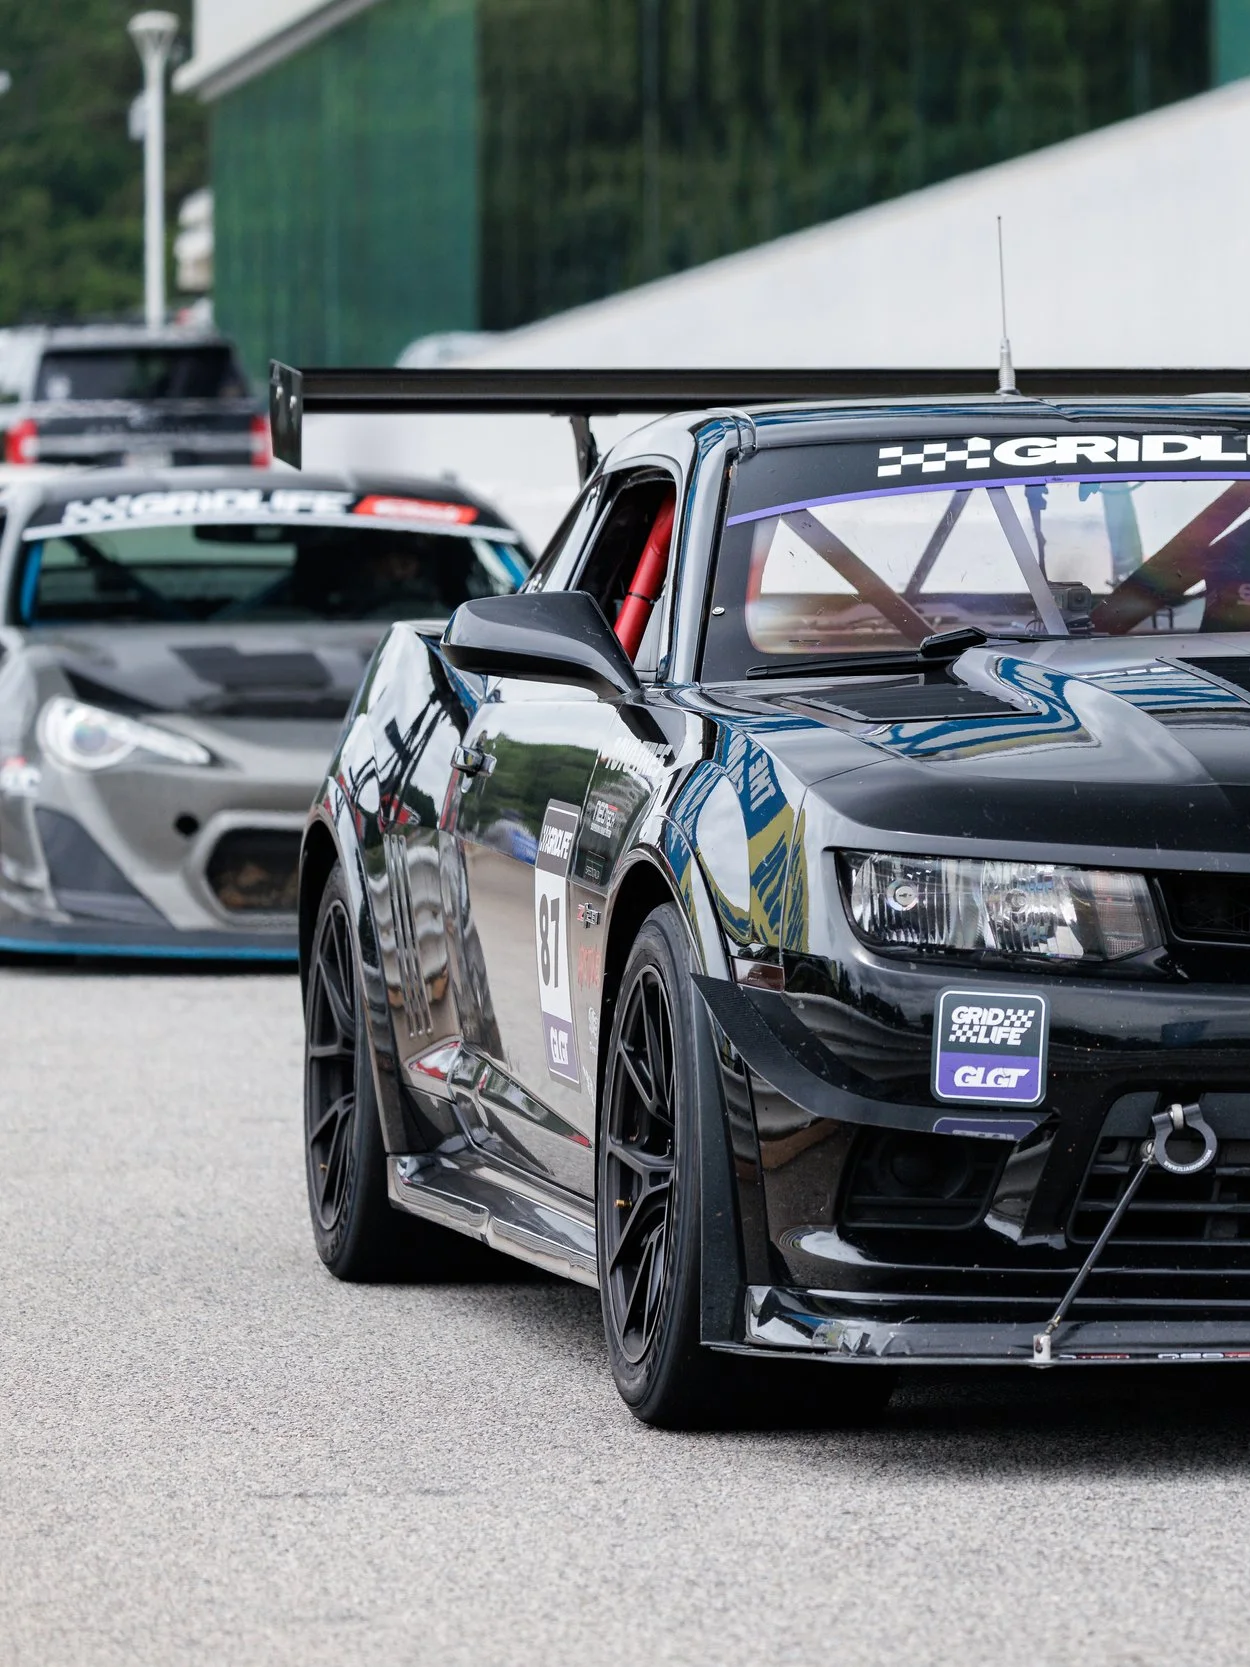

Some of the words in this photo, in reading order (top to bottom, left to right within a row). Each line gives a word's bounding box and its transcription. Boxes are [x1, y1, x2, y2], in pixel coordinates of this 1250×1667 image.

[130, 488, 356, 517] GRIDLIFE
[951, 1005, 1005, 1026] GRID
[976, 1024, 1028, 1046] LIFE
[953, 1065, 1030, 1088] GLGT
